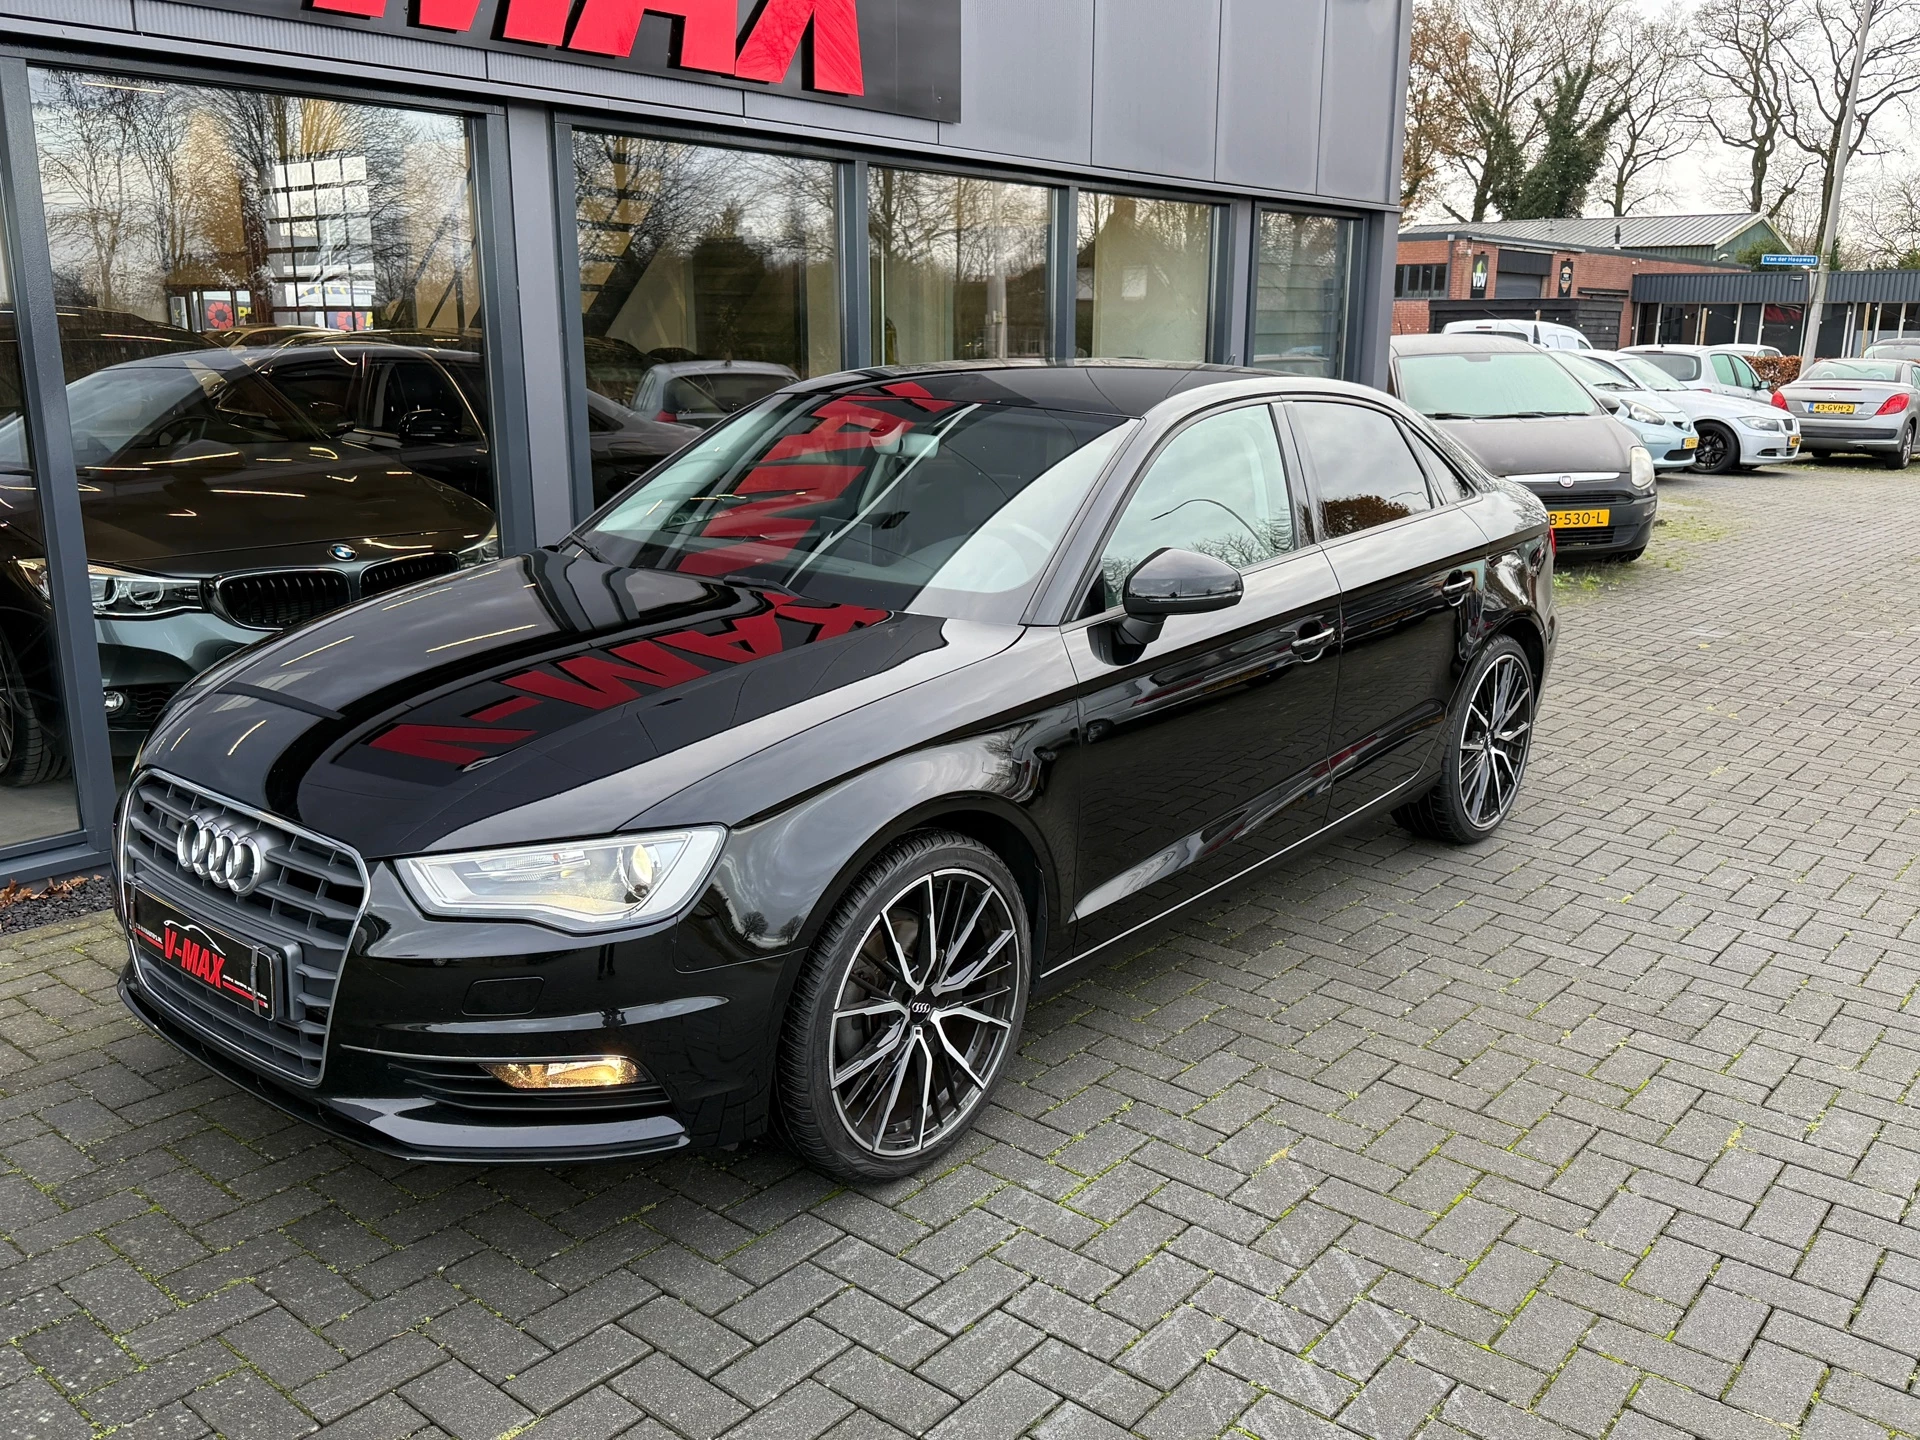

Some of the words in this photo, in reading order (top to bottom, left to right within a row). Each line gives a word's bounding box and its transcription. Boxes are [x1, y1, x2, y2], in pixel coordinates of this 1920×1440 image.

[1815, 404, 1851, 412] 43-GVH-2
[1549, 512, 1604, 526] B-530-L
[164, 927, 225, 988] V-MAX
